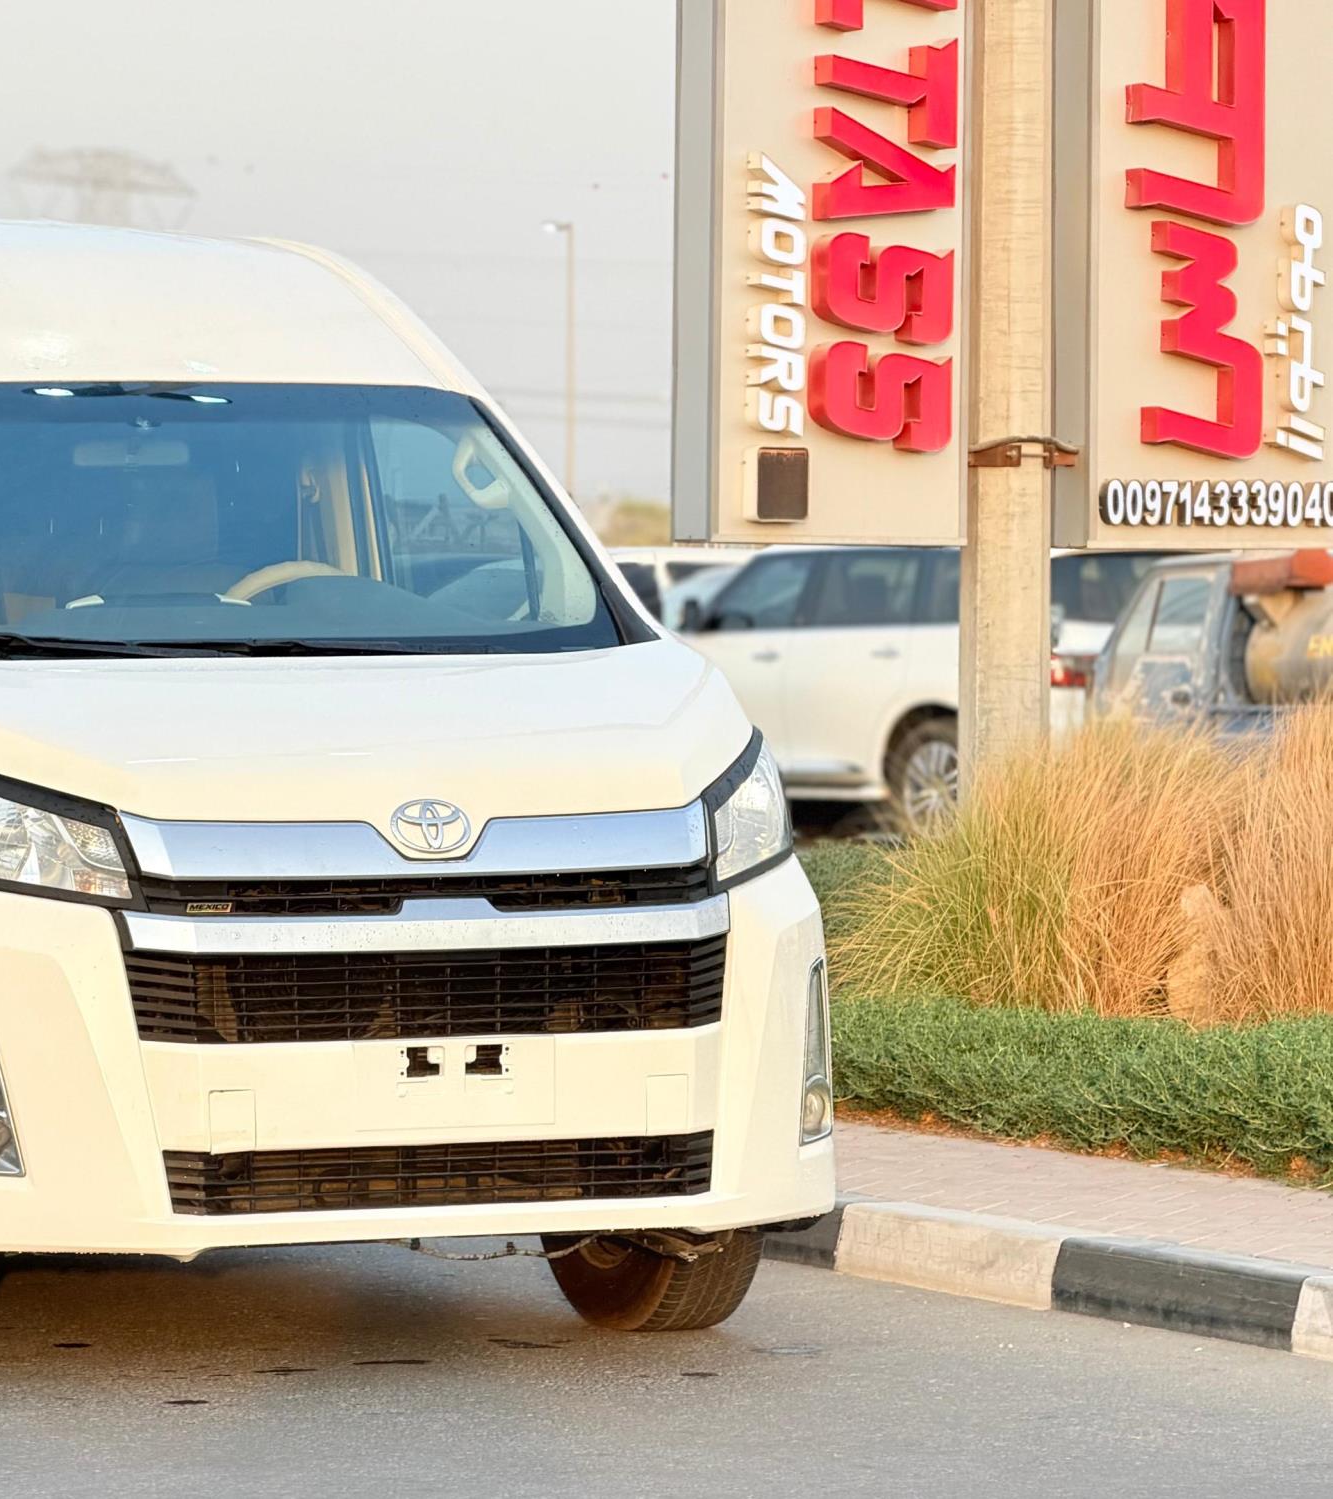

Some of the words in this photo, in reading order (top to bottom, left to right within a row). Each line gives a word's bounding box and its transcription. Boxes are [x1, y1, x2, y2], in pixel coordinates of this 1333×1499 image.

[747, 150, 807, 438] MOTORS
[807, 0, 959, 453] TASS
[188, 903, 230, 911] MEXICO
